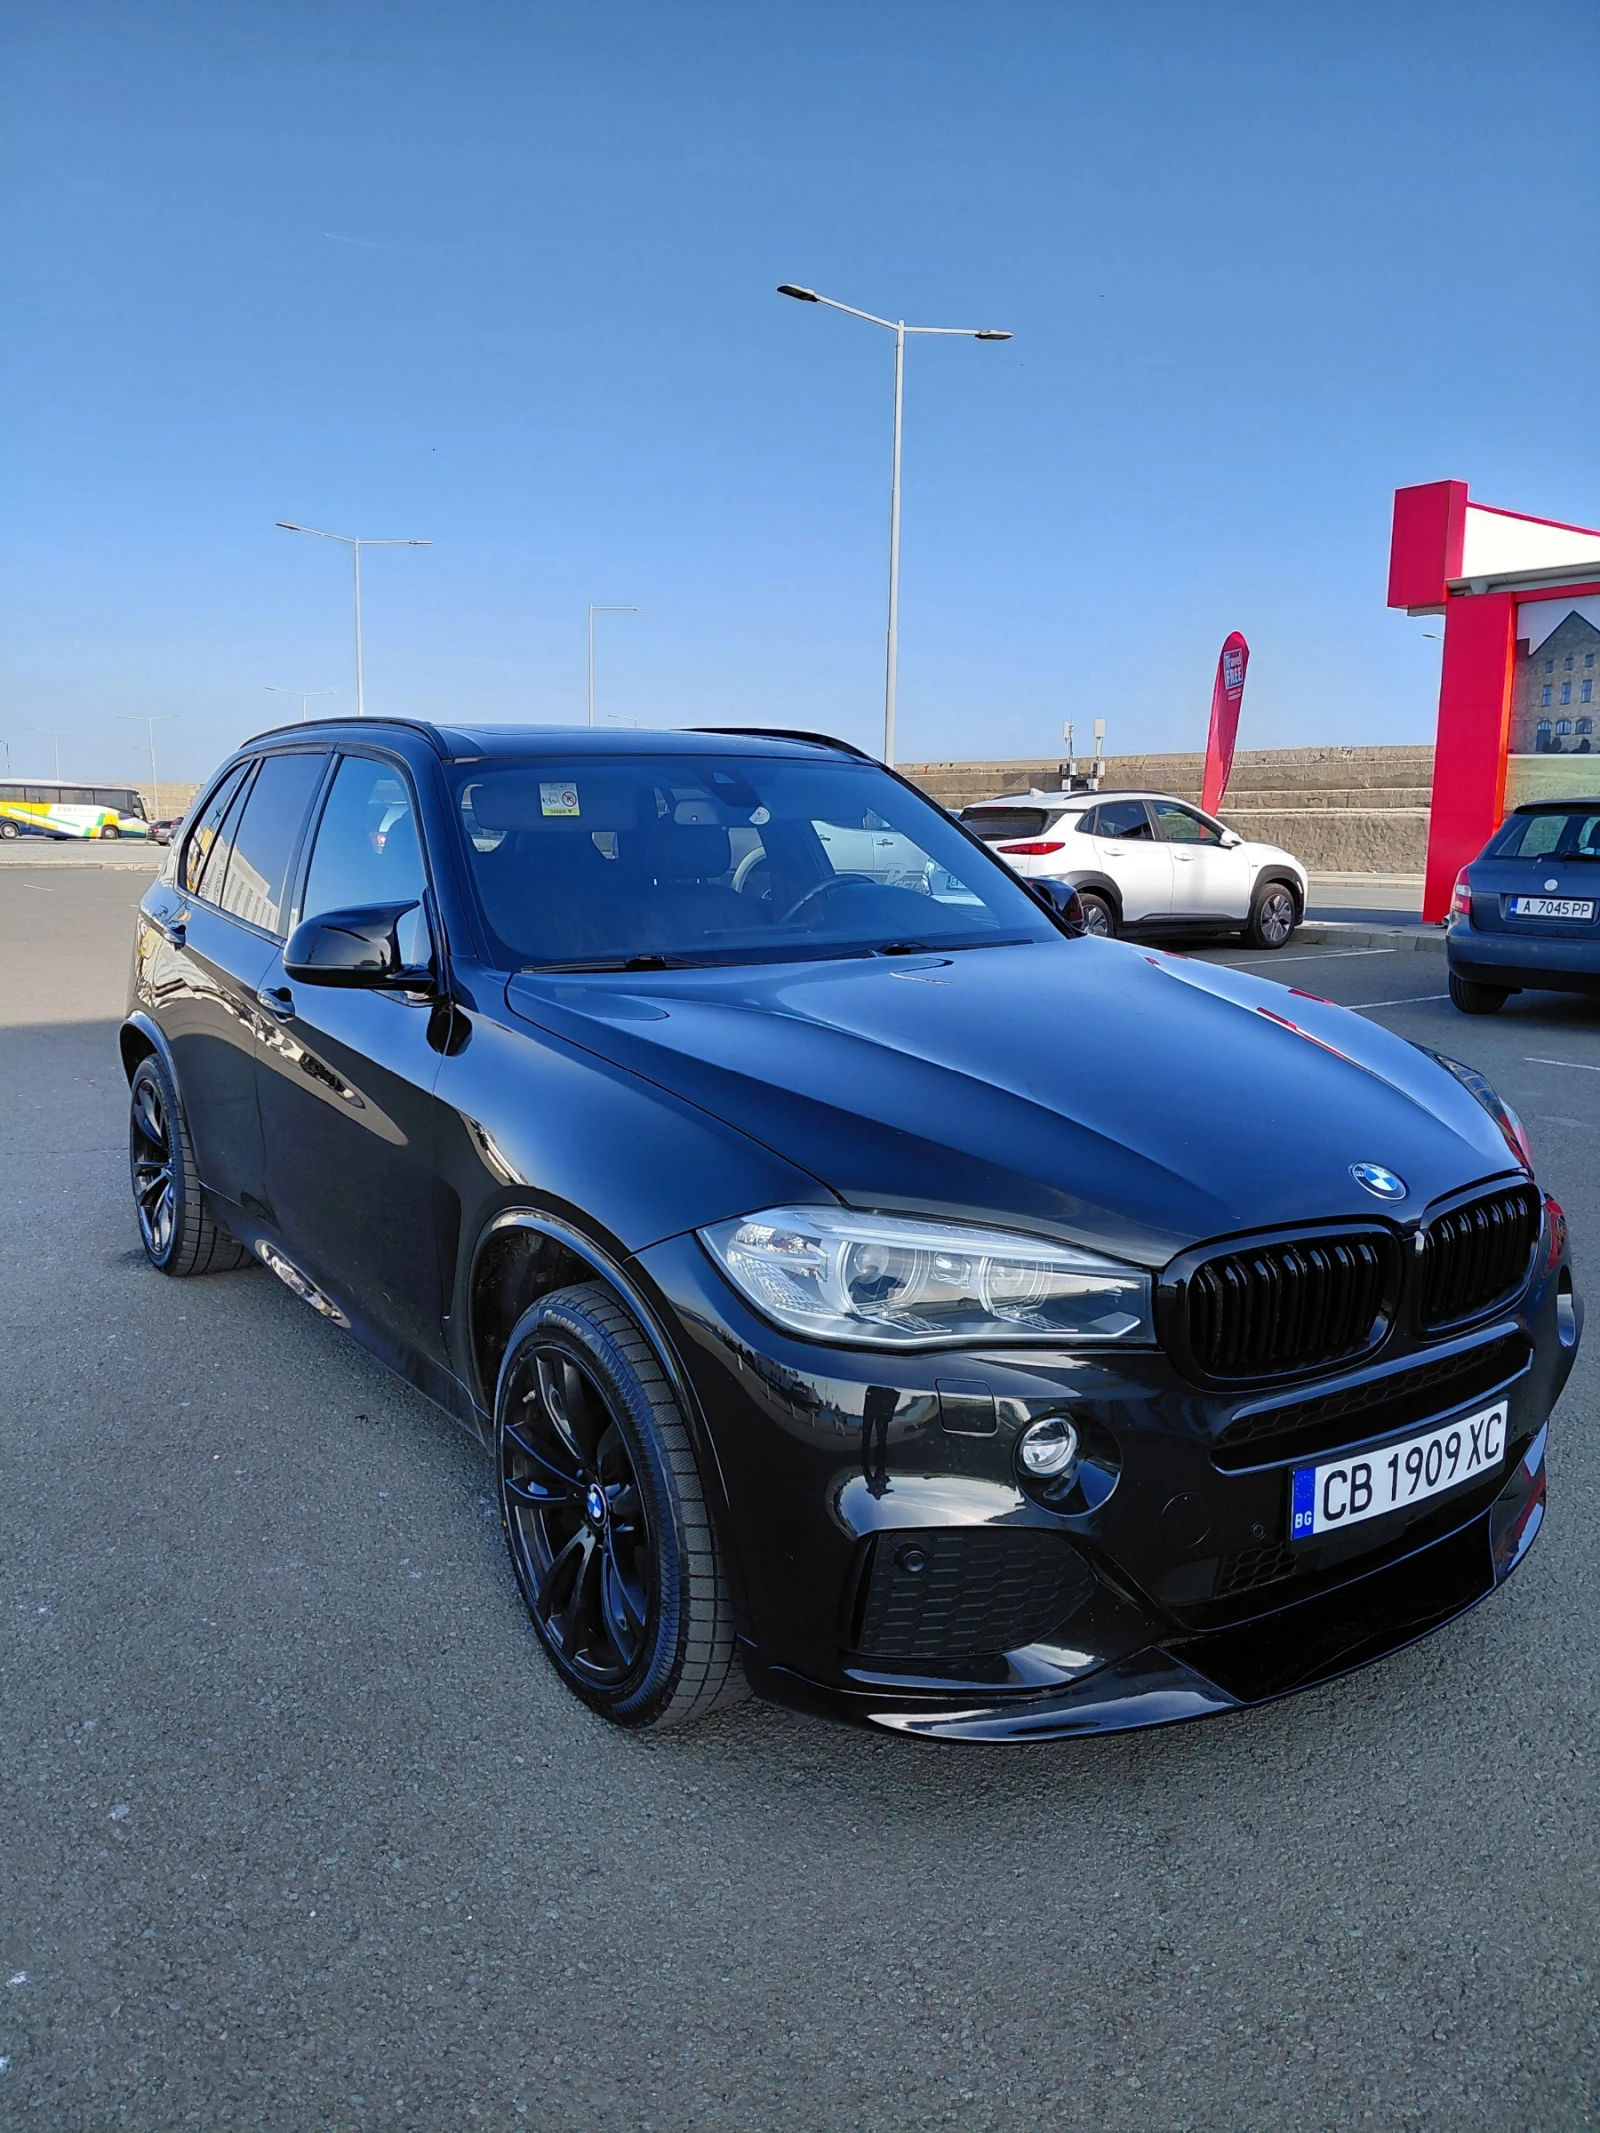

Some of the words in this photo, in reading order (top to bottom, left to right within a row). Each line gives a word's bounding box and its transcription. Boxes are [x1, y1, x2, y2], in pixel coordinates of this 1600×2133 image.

[1225, 652, 1242, 669] Travel
[1226, 667, 1243, 687] FREE
[1523, 900, 1531, 913] A
[1538, 901, 1570, 915] 7045
[1572, 903, 1590, 916] PP
[1323, 1462, 1372, 1522] CB
[1388, 1432, 1461, 1501] 1909
[1466, 1412, 1502, 1471] XC
[1294, 1511, 1313, 1529] BG
